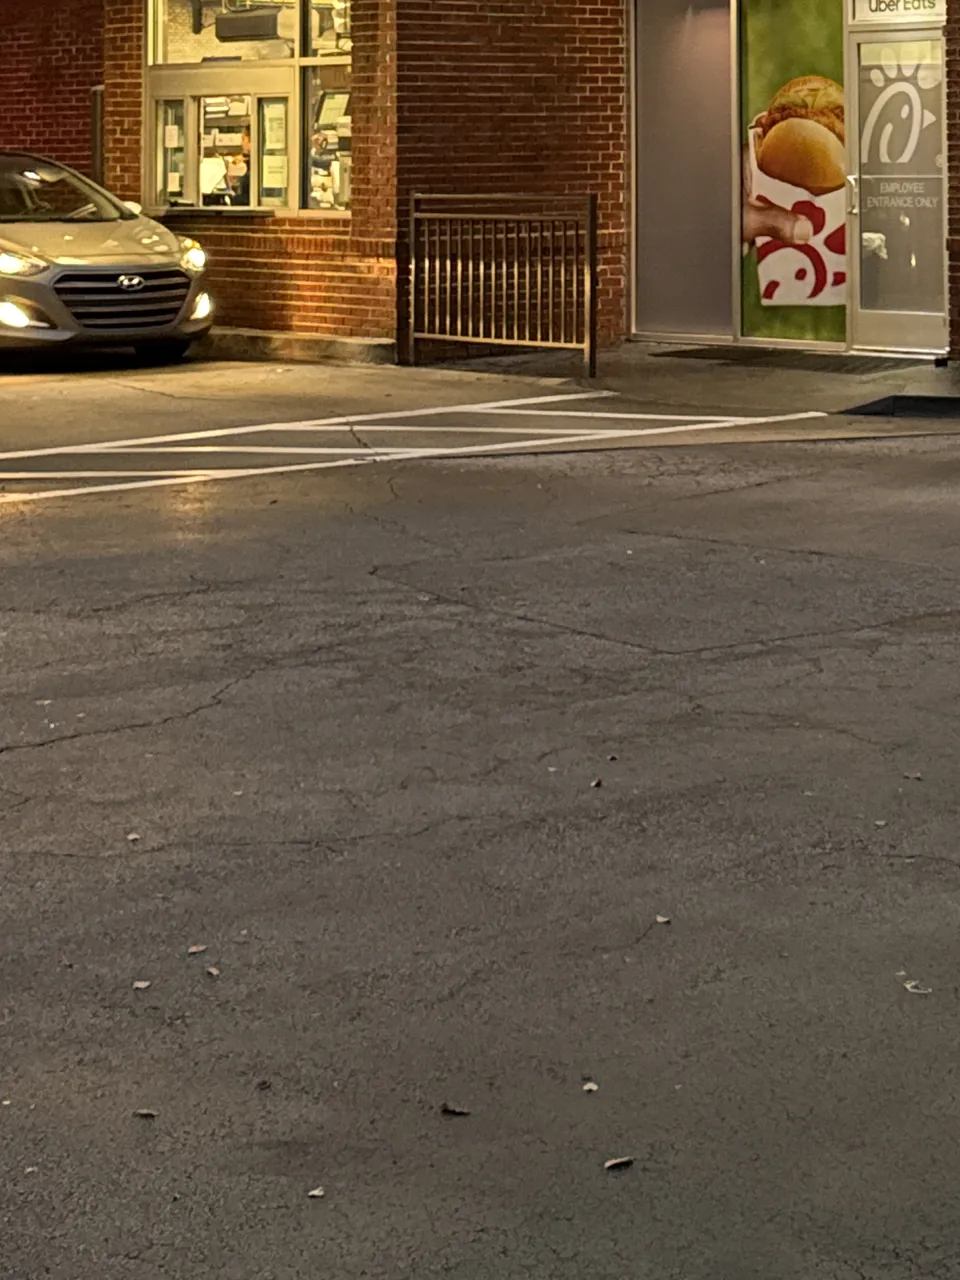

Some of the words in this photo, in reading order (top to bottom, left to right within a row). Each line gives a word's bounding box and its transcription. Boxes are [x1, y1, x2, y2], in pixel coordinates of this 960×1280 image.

[880, 182, 925, 193] EMPLOYEE
[867, 196, 913, 208] ENTRANCE
[915, 196, 939, 208] ONLY
